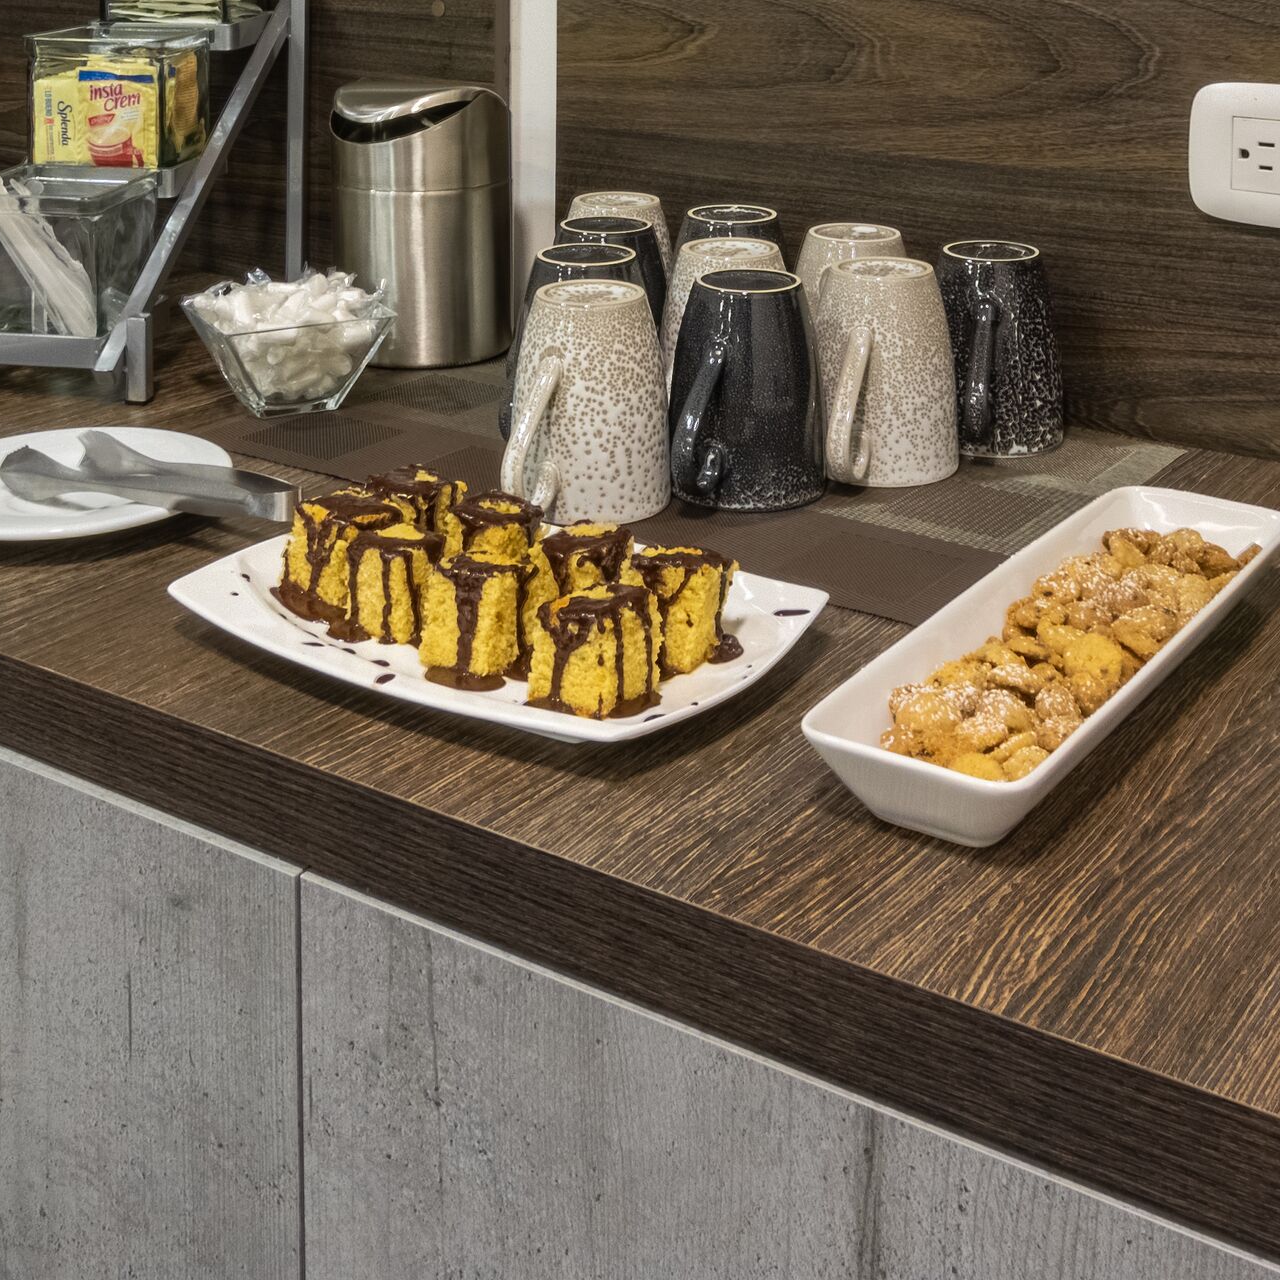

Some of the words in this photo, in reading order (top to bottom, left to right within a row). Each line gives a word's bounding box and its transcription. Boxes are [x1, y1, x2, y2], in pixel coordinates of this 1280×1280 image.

[89, 83, 123, 101] insta
[104, 92, 141, 112] crem
[57, 101, 73, 147] Splenda
